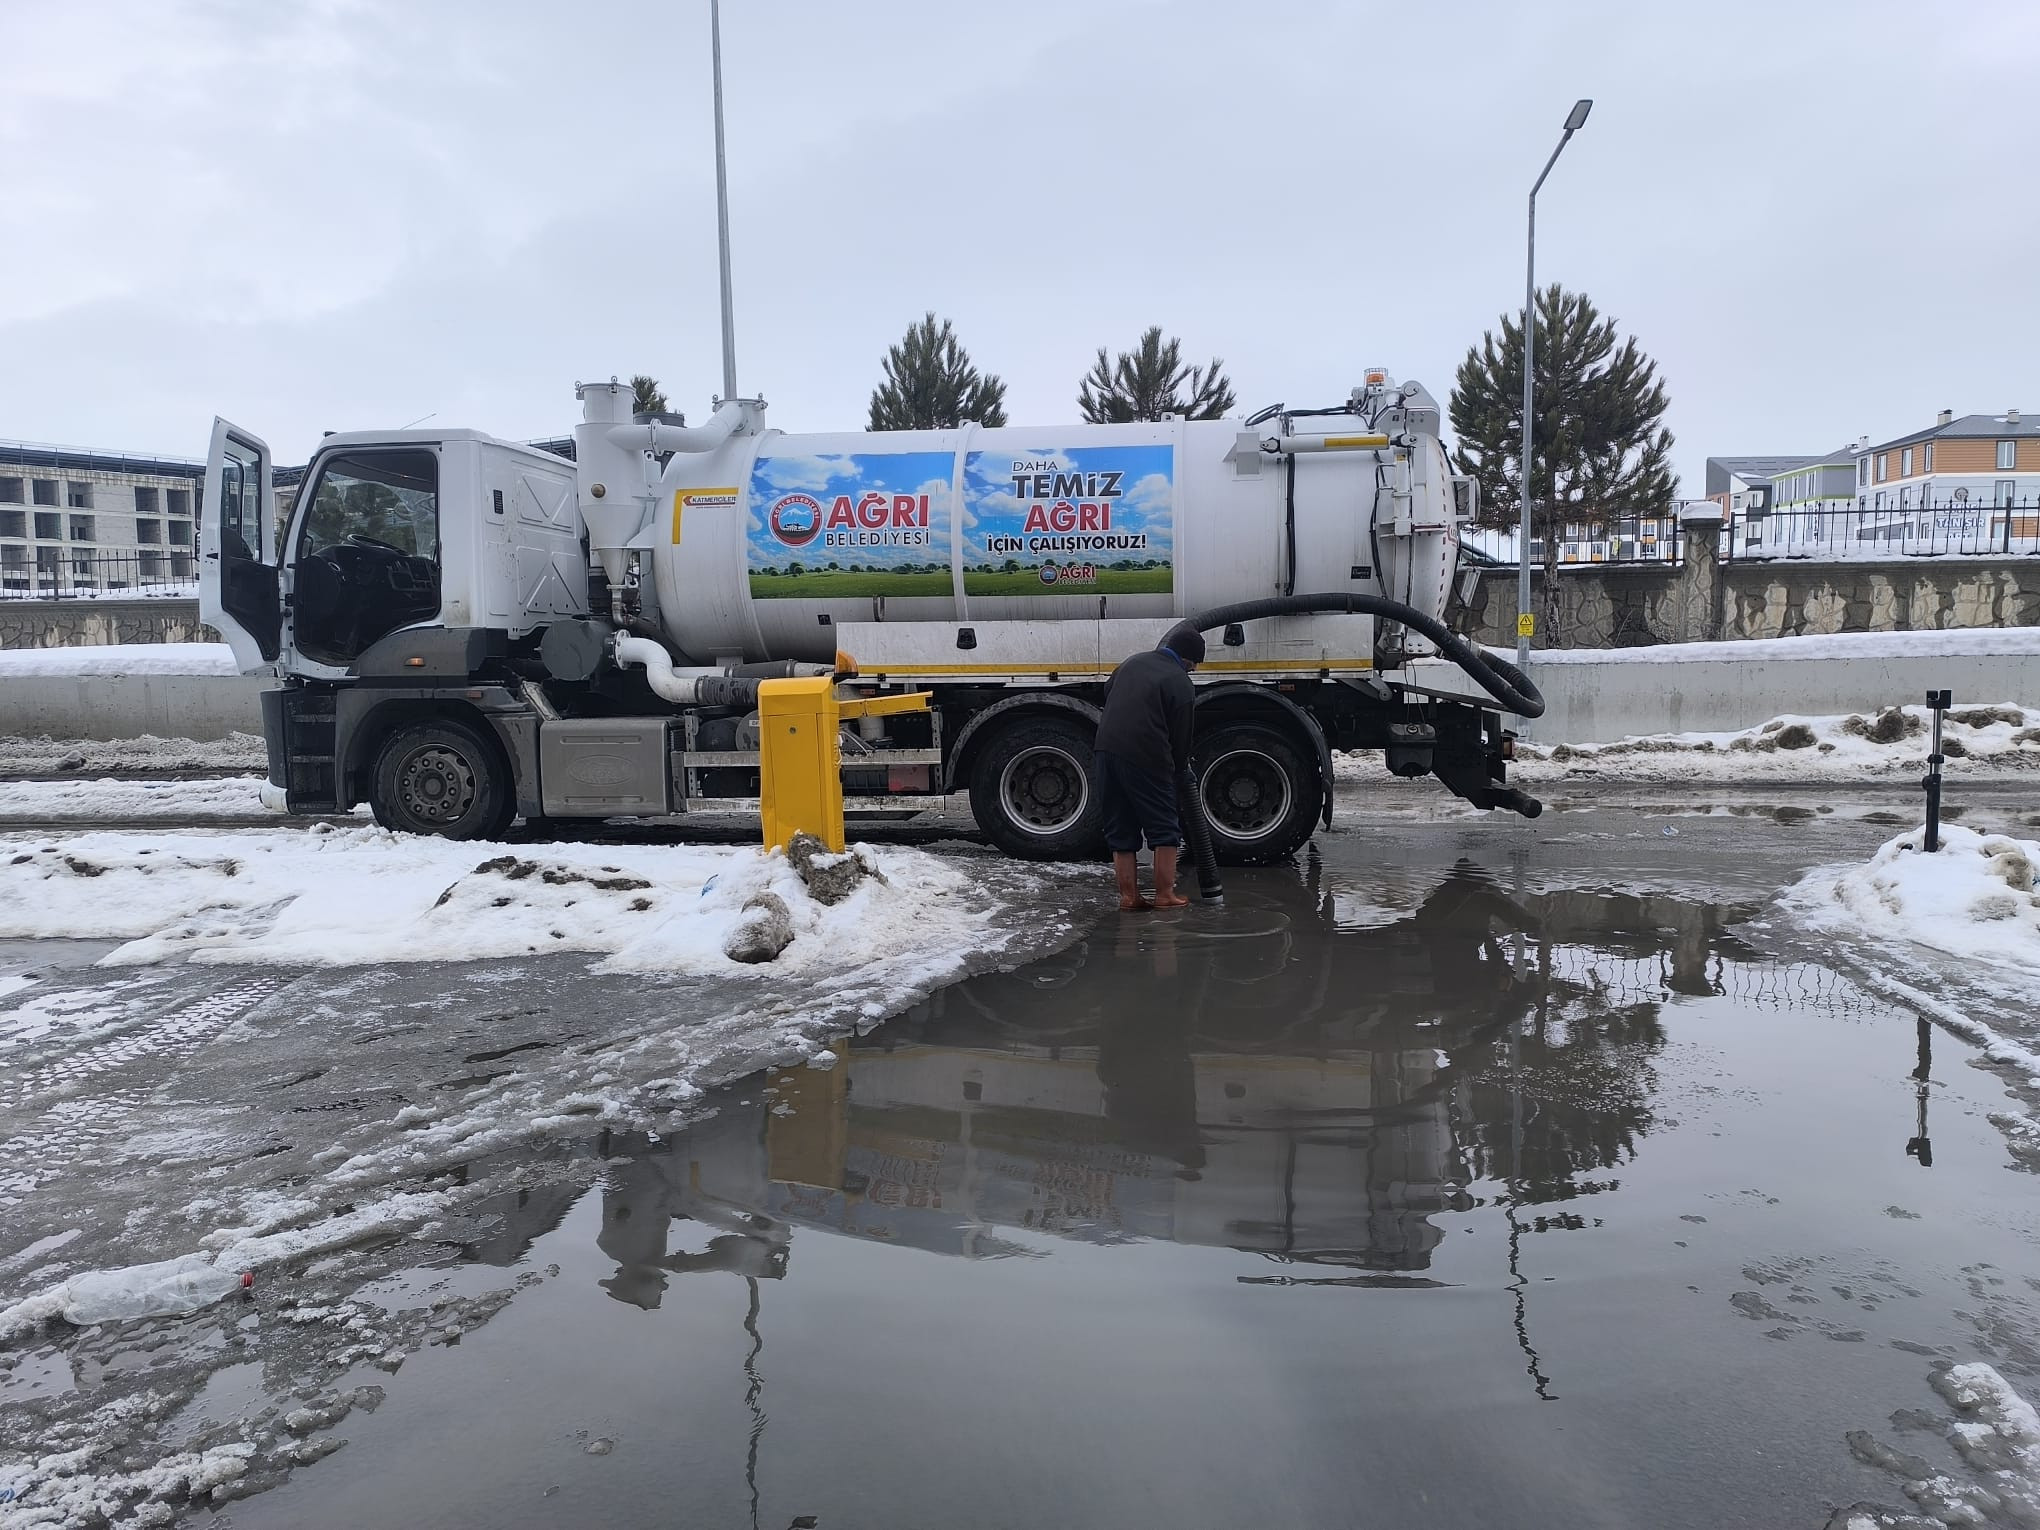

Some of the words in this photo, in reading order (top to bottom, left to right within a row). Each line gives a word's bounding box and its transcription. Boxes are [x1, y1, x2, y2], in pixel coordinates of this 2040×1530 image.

[1012, 461, 1058, 472] DAHA
[1012, 472, 1123, 498] TEMİZ
[826, 493, 929, 529] AĞRI
[1024, 501, 1110, 532] AĞRI
[826, 529, 930, 546] BELEDİYESİ
[987, 534, 1023, 556] İÇİN
[1029, 534, 1146, 555] ÇALIŞIYORUZ!
[1060, 565, 1096, 579] AĞRI
